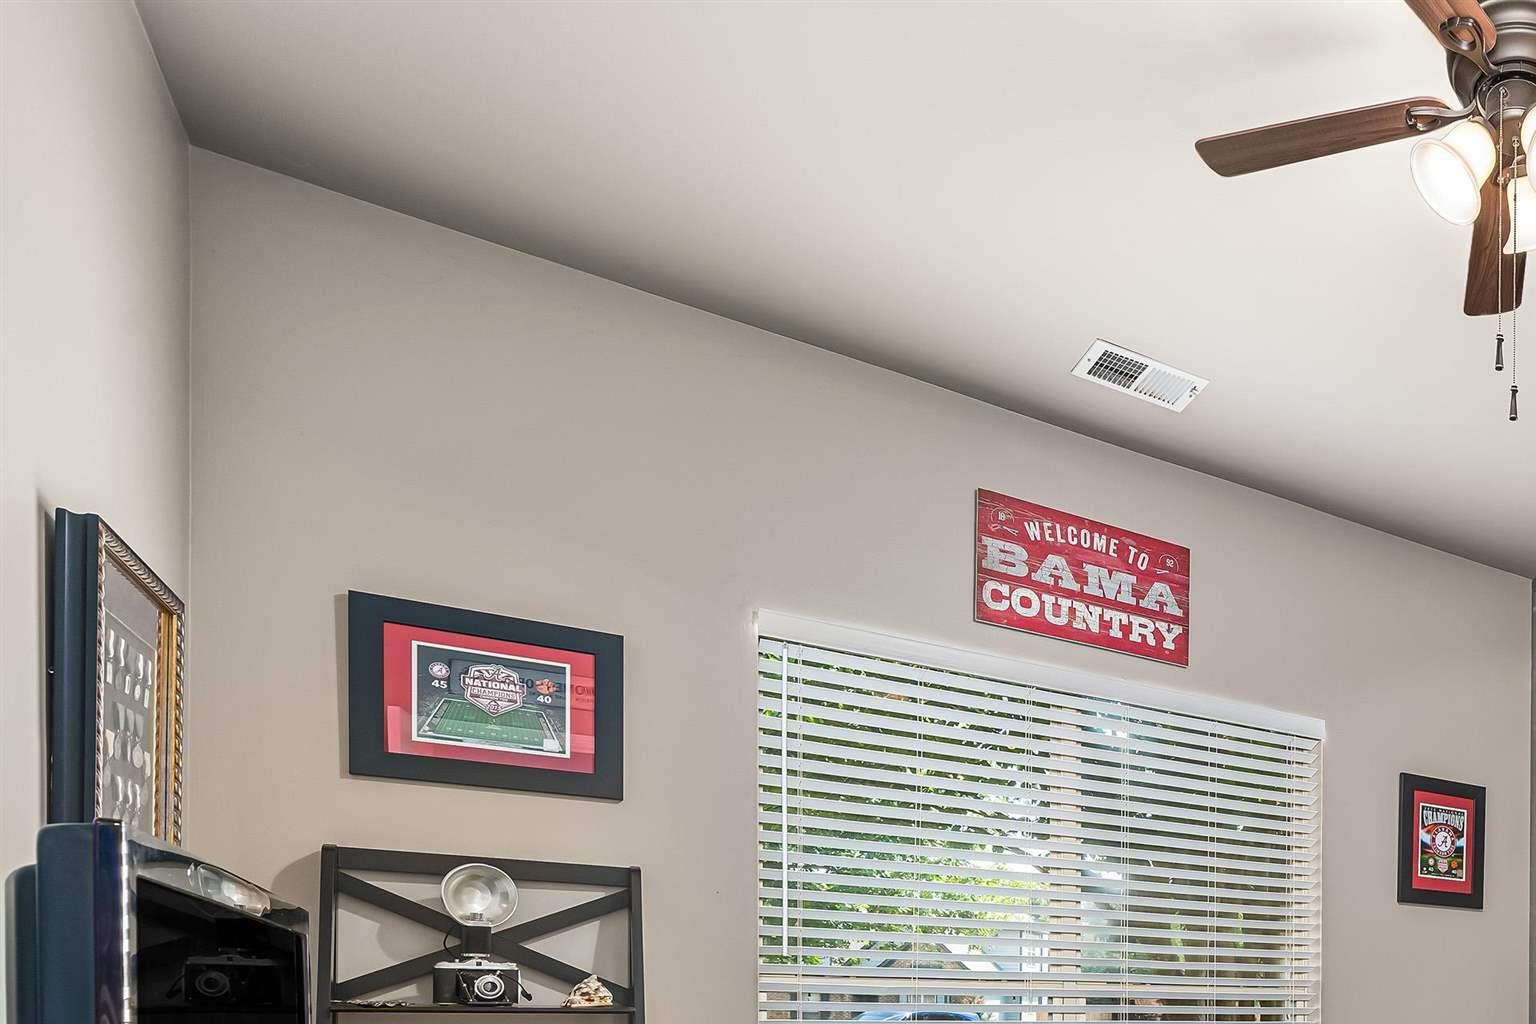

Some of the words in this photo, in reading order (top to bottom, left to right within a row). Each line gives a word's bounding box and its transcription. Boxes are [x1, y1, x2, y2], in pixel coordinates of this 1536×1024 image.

[1024, 521, 1119, 557] WELCOME
[1128, 545, 1149, 571] TO
[981, 535, 1184, 617] BAMA
[982, 581, 1183, 650] COUNTRY
[431, 680, 447, 689] 45
[464, 677, 523, 693] NATIONAL
[471, 687, 516, 699] CHAMPIONS
[537, 695, 552, 704] 40
[1423, 810, 1464, 831] CHAMPIONS
